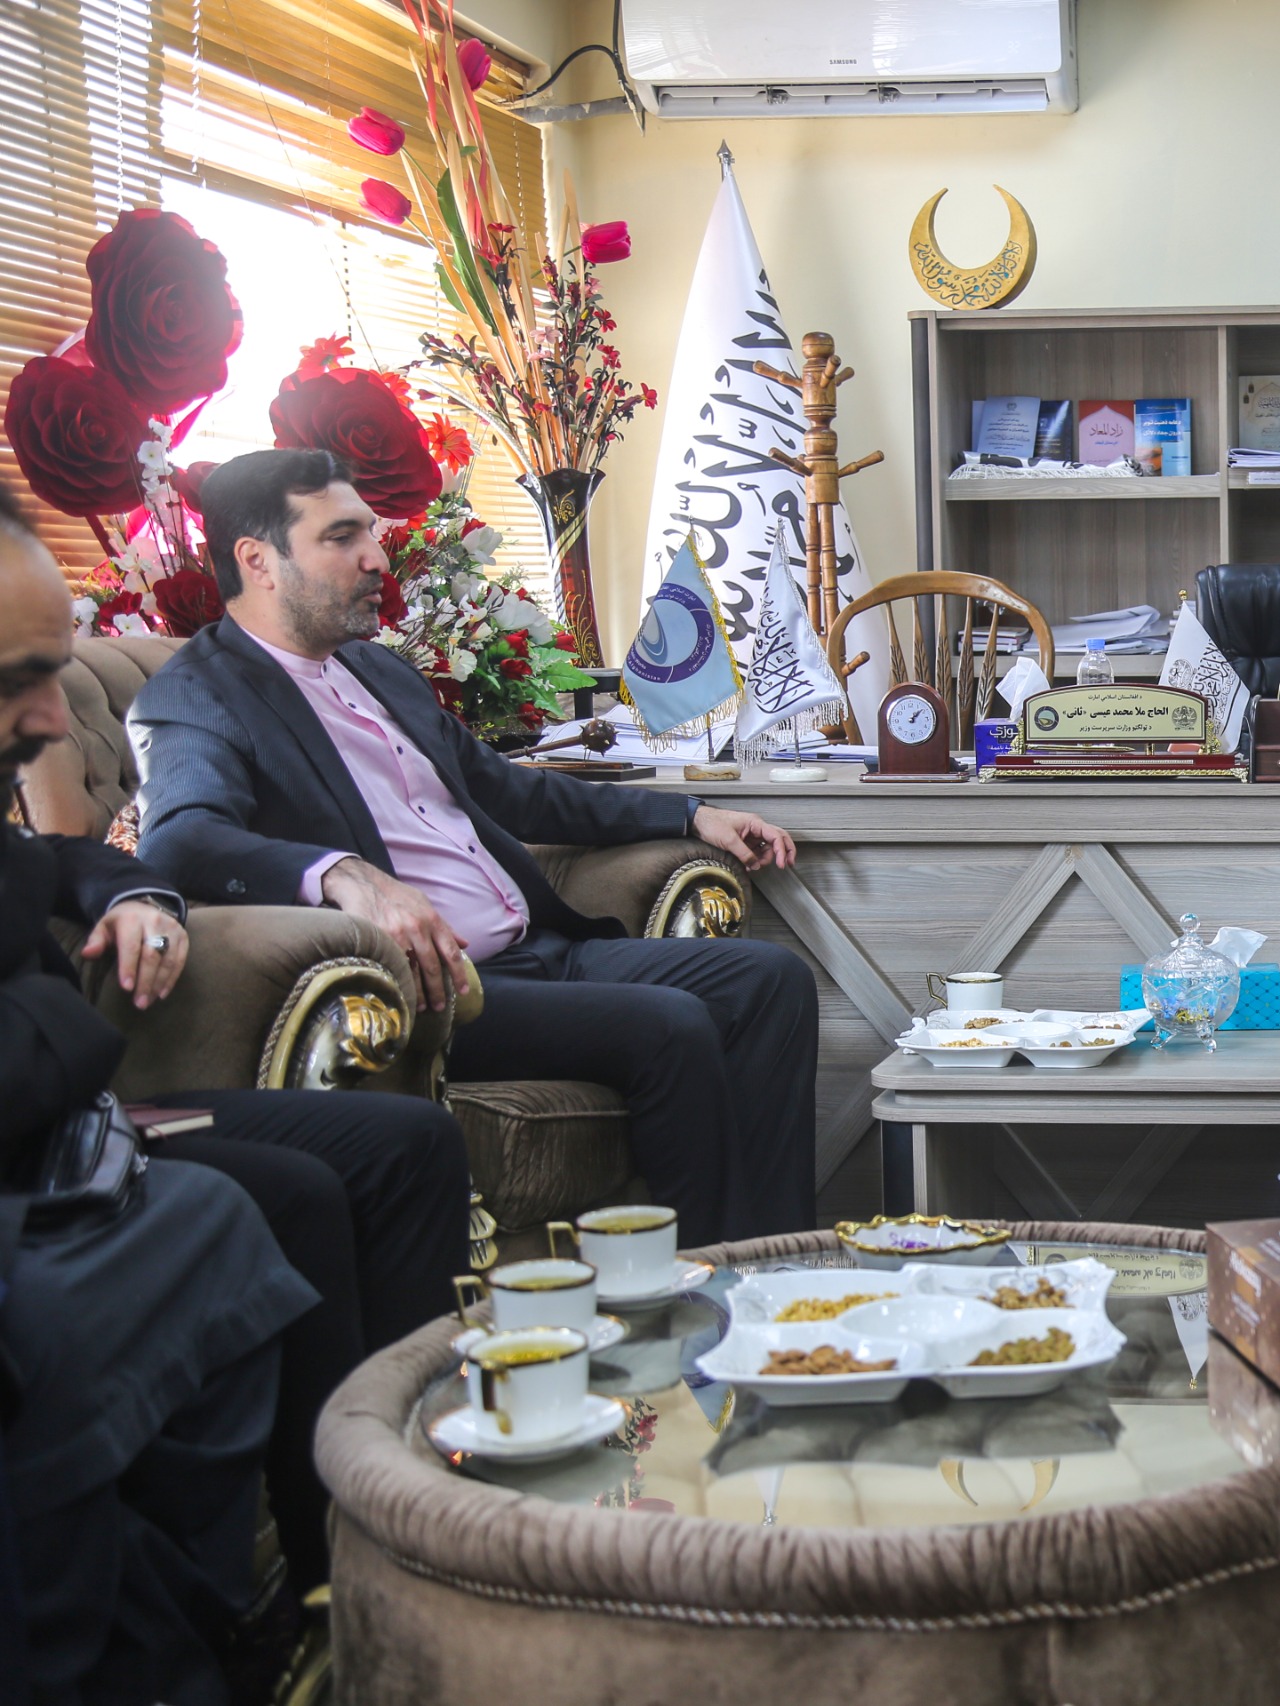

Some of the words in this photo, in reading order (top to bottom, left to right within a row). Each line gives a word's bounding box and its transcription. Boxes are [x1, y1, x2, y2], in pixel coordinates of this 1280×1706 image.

[1112, 707, 1134, 717] محمد
[1134, 706, 1148, 716] ملا
[1148, 706, 1169, 718] الحاج
